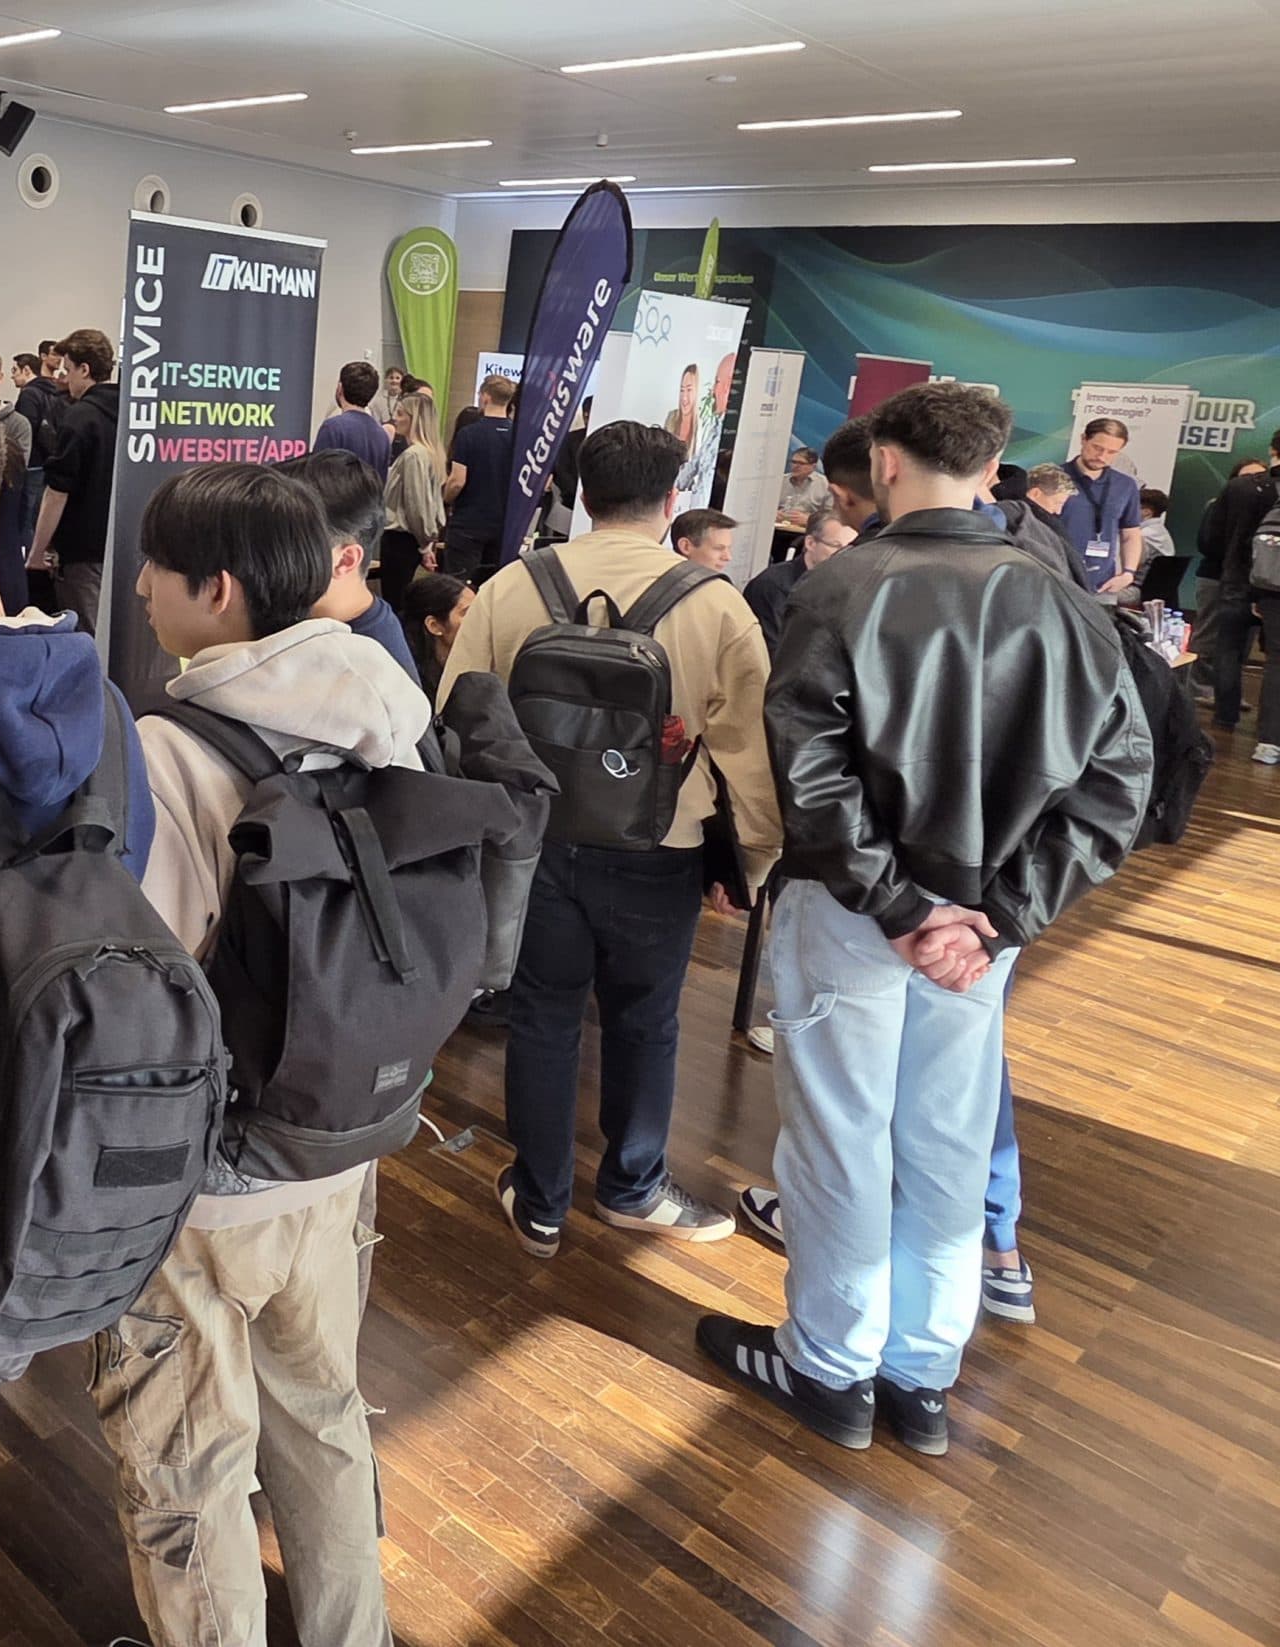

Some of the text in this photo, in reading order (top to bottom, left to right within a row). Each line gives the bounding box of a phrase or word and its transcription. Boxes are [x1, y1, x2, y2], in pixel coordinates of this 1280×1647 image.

[128, 244, 165, 463] SERVICE
[161, 361, 281, 391] IT-SERVICE
[518, 277, 612, 497] Planisware
[1083, 404, 1151, 418] IT-Strategie?
[1086, 392, 1179, 406] Immer noch keine
[160, 401, 275, 427] NETWORK
[157, 437, 306, 465] WEBSITE/APP
